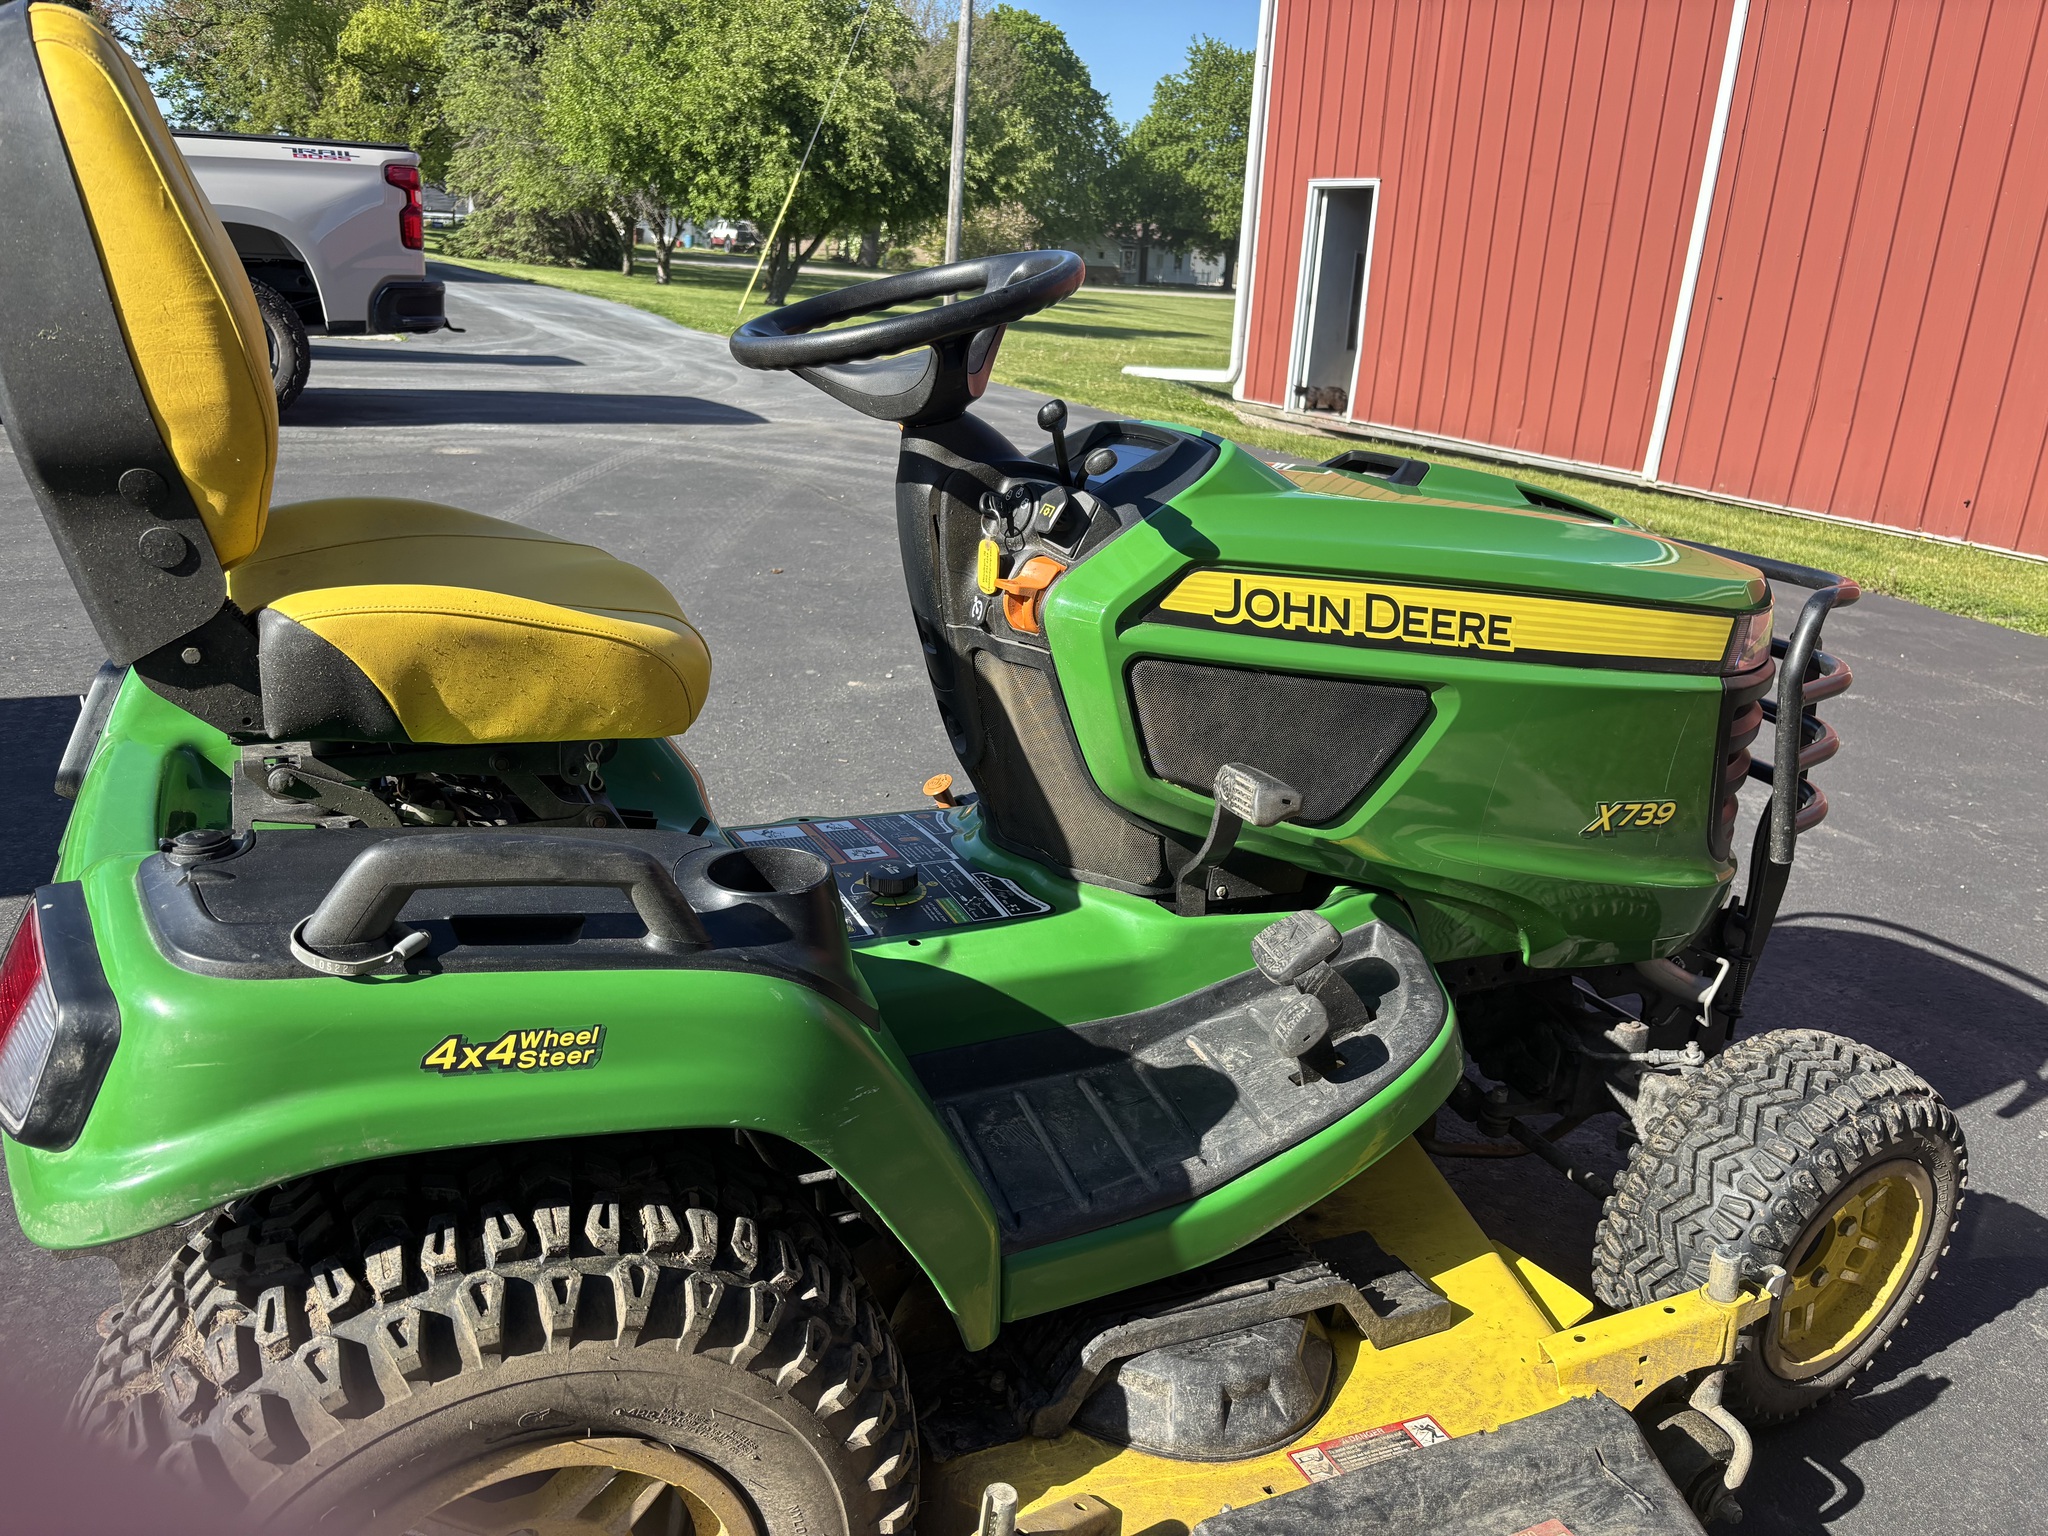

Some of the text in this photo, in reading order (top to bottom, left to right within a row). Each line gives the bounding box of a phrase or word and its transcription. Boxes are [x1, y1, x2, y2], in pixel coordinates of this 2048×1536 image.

[282, 147, 359, 157] TRAIL
[1214, 578, 1513, 647] JOHN DEERE
[1585, 801, 1677, 831] X739
[520, 1026, 599, 1049] Wheel
[425, 1034, 517, 1070] 4x4
[517, 1048, 594, 1069] Steer
[1348, 1428, 1386, 1443] DANGER
